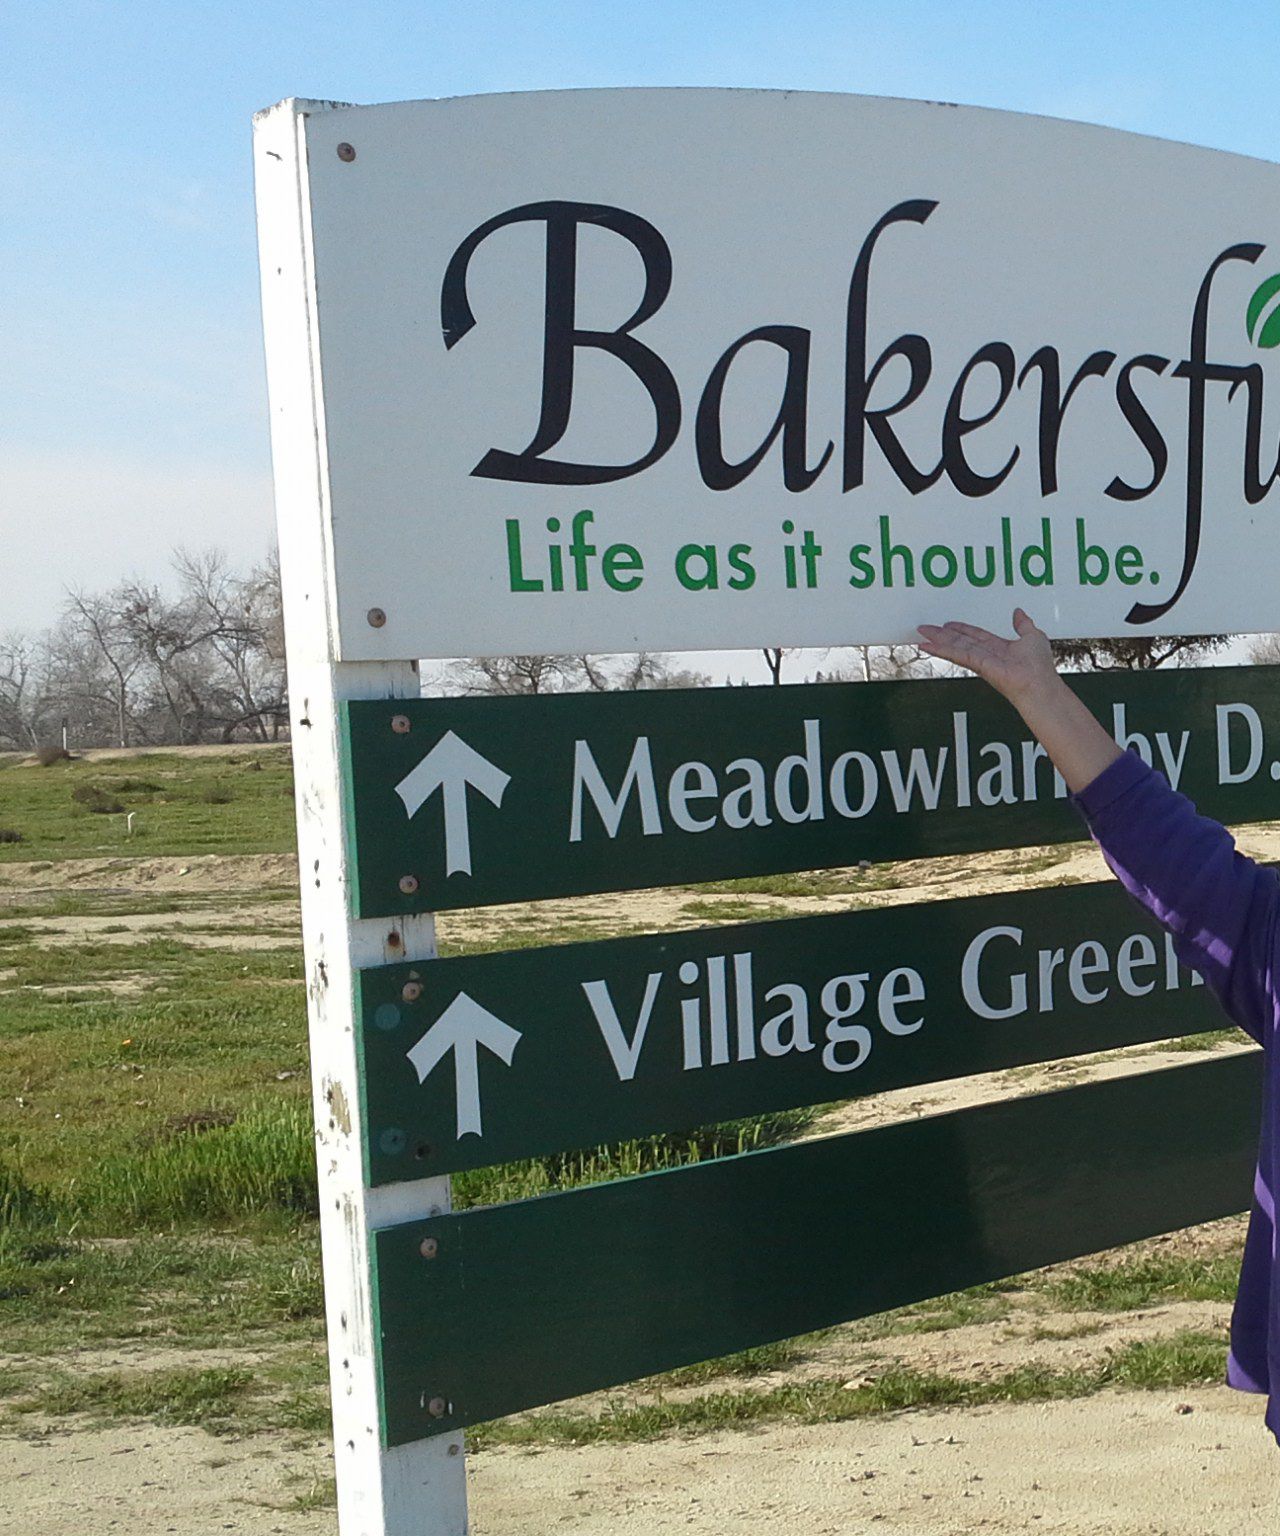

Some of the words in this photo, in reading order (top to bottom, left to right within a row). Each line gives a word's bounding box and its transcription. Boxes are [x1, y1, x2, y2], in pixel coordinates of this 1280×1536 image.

[505, 509, 644, 593] Life
[674, 545, 757, 591] as
[782, 520, 822, 589] it
[849, 515, 1055, 588] should
[1076, 517, 1160, 586] be.
[569, 711, 1067, 842] Meadowlar
[581, 952, 925, 1081] Village
